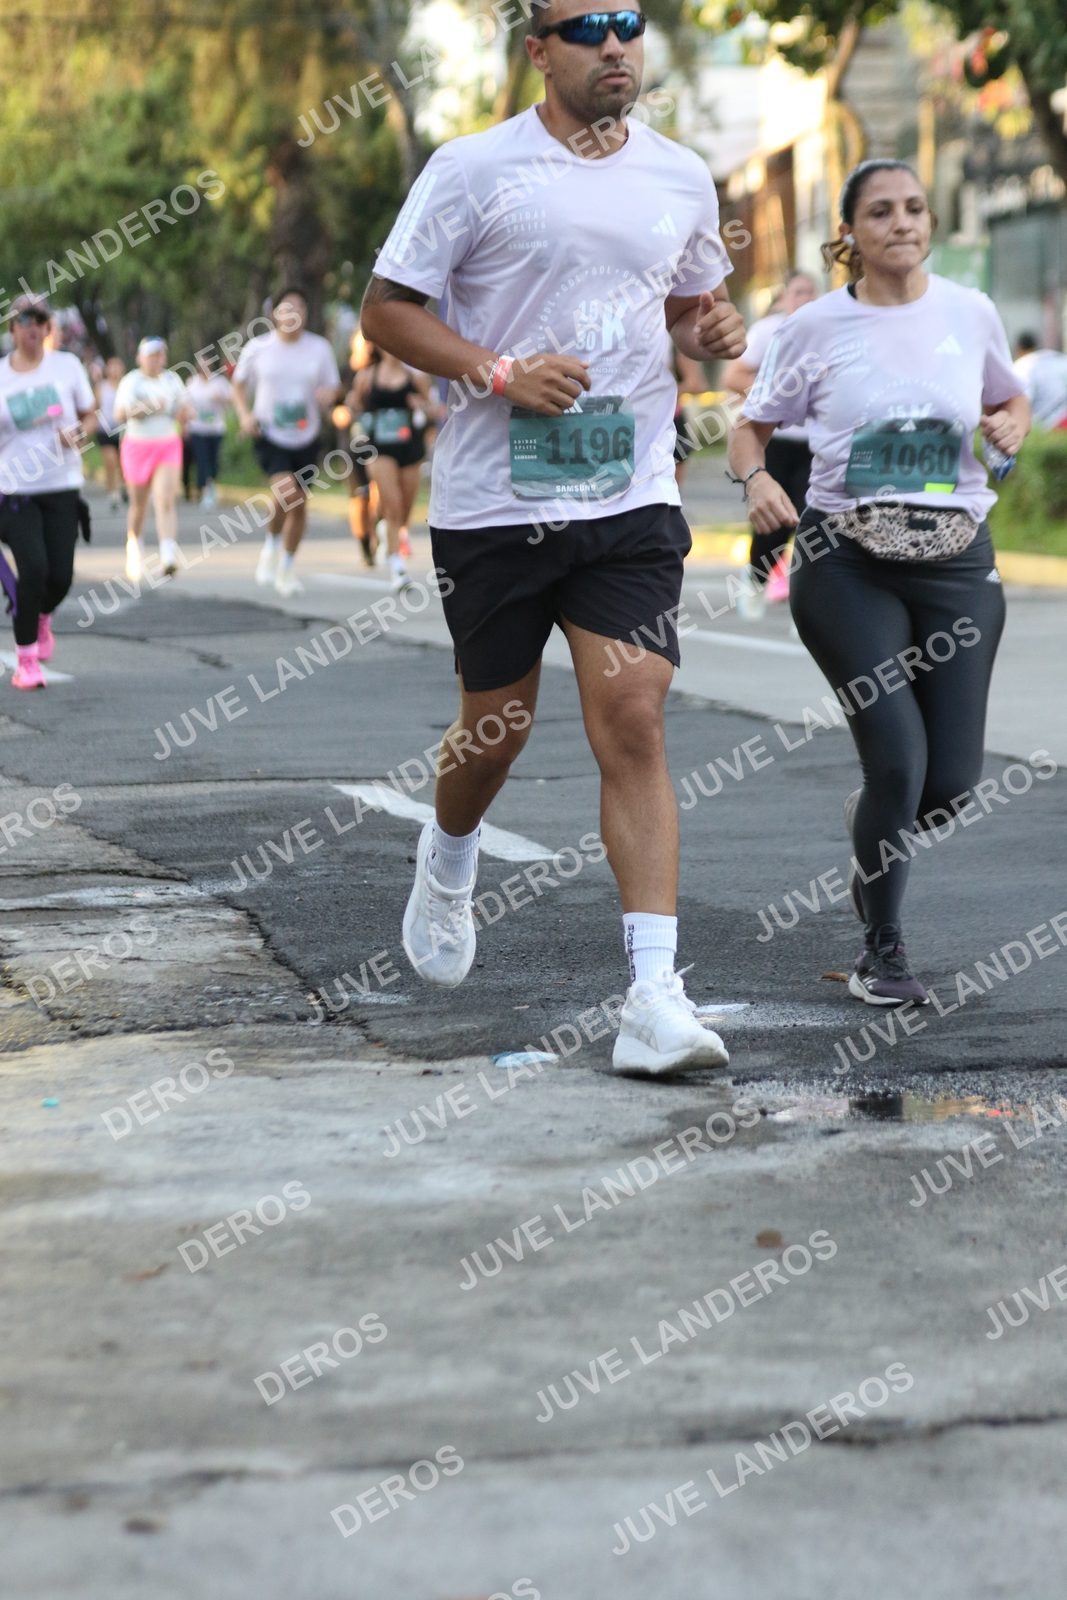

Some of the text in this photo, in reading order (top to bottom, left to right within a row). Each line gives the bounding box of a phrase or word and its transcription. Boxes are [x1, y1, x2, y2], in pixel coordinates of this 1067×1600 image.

[545, 426, 631, 464] 1196
[879, 442, 956, 475] 1060
[556, 483, 597, 493] SAMSUNG
